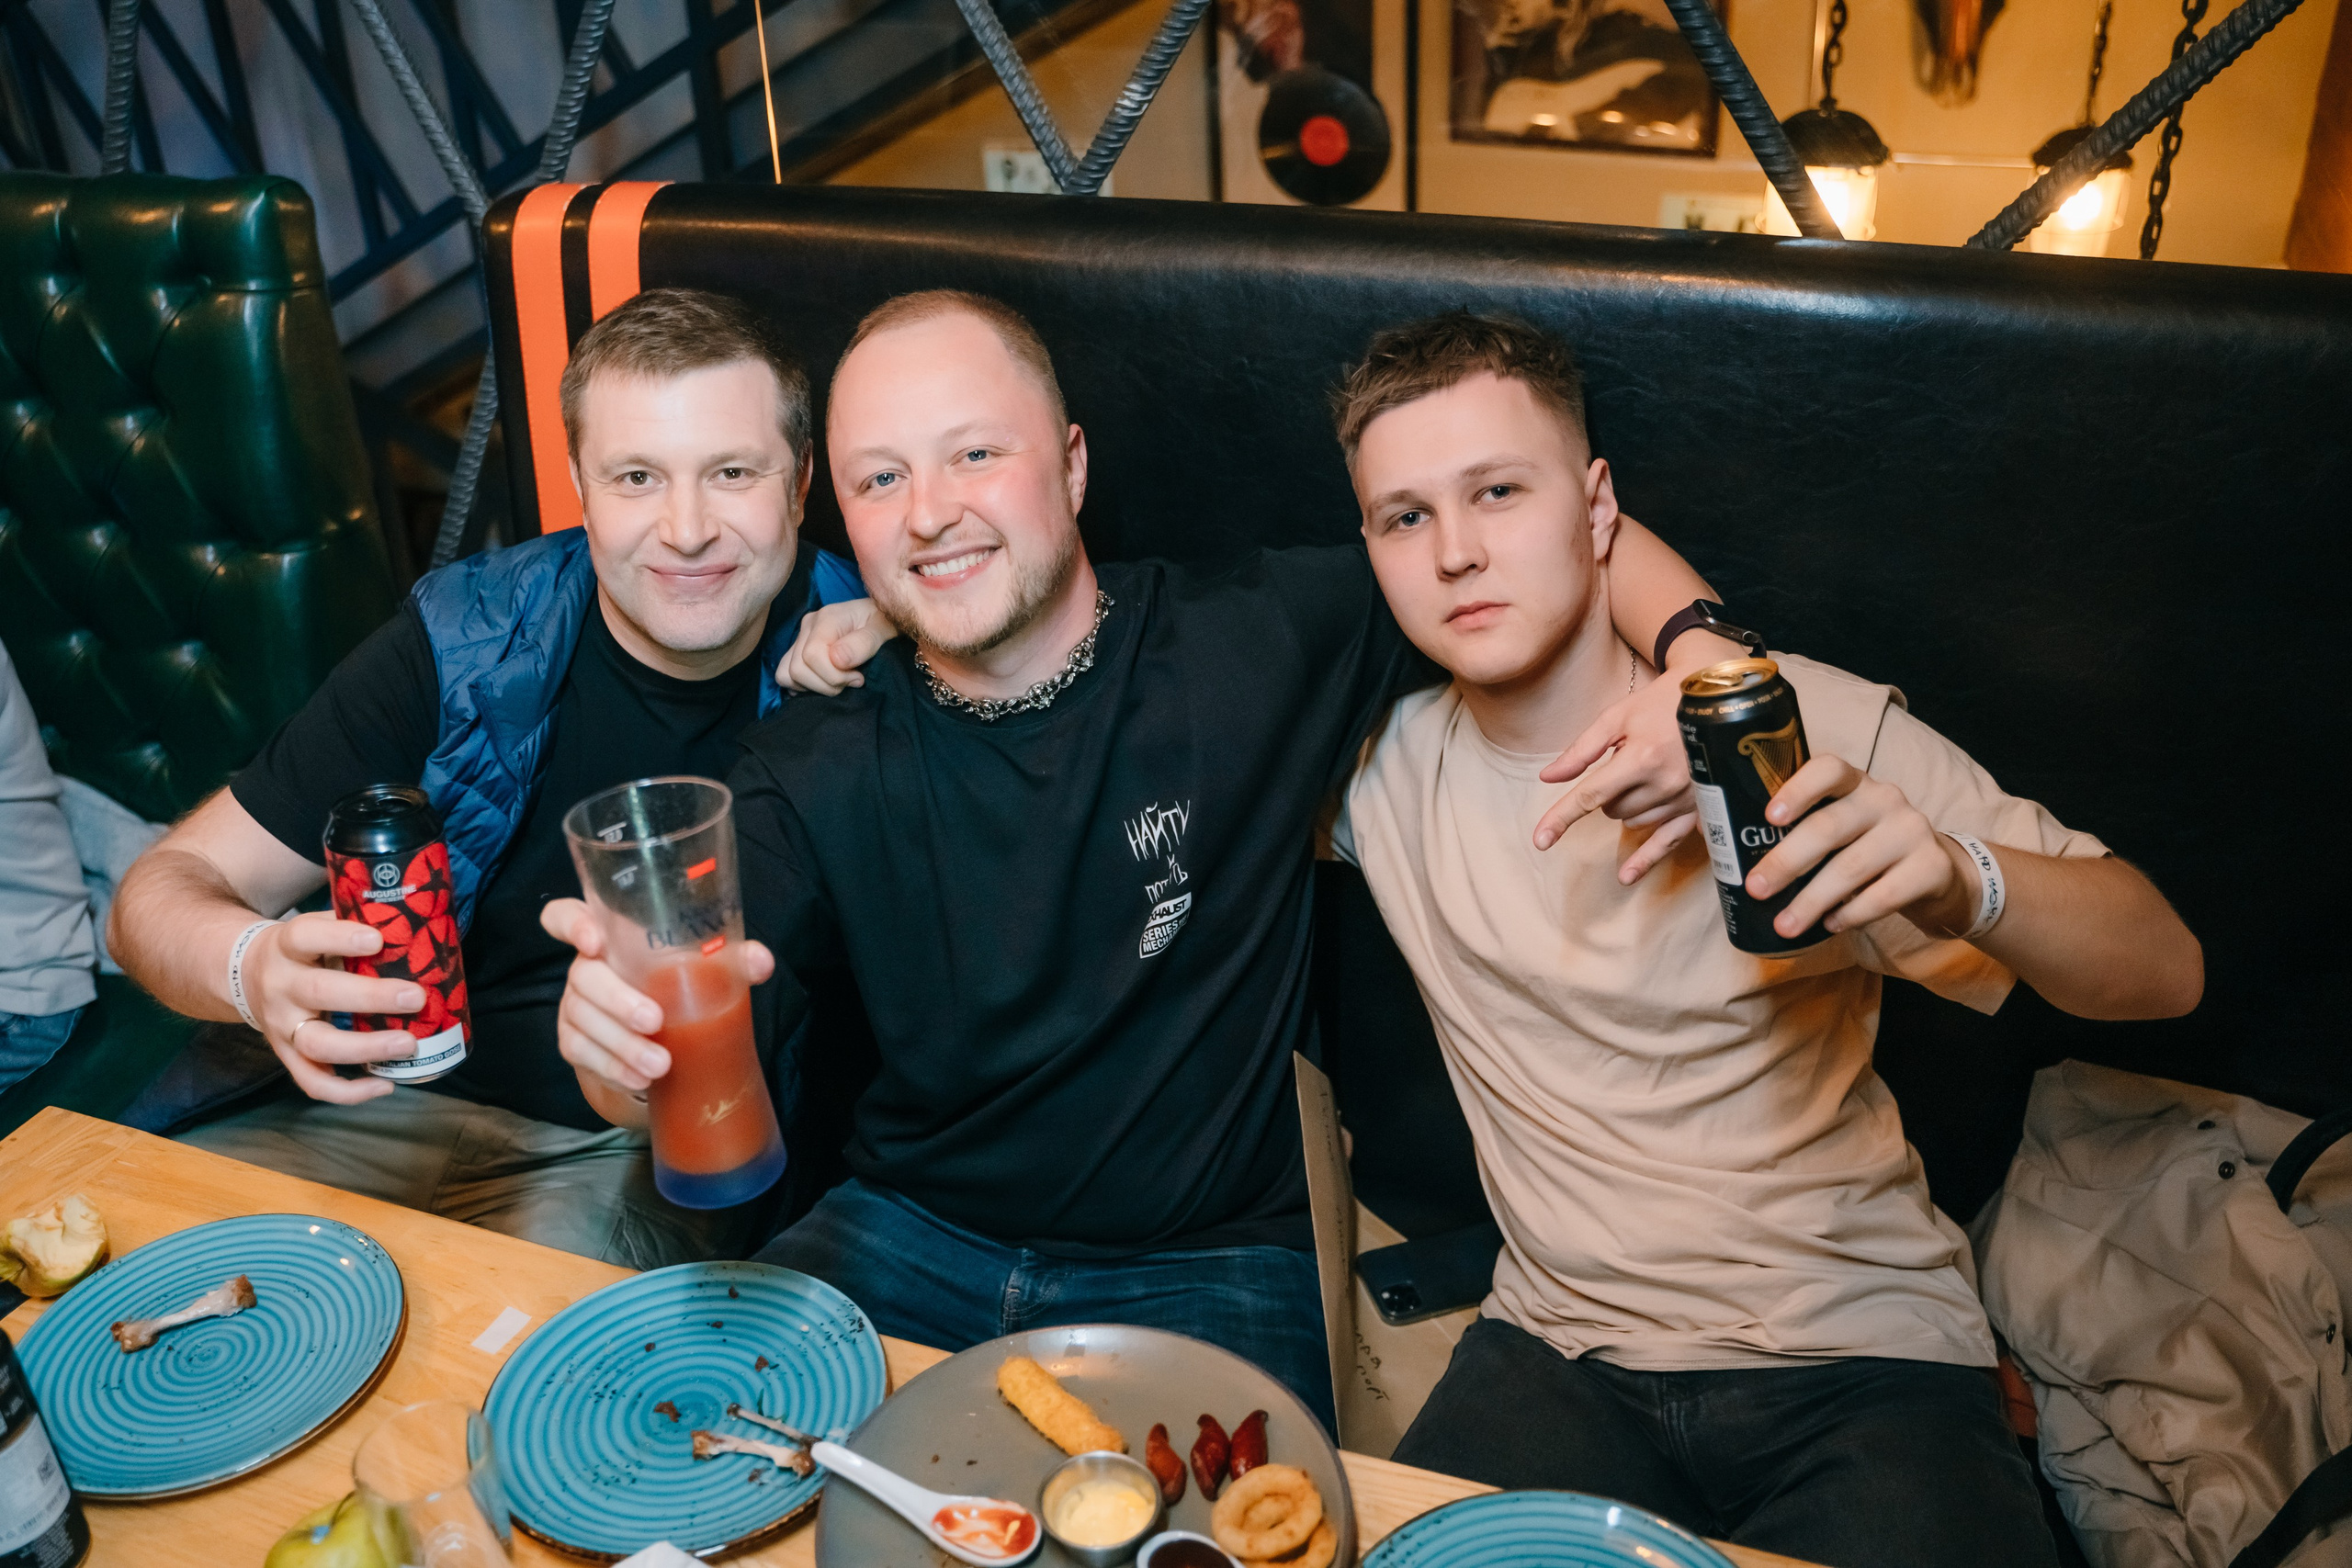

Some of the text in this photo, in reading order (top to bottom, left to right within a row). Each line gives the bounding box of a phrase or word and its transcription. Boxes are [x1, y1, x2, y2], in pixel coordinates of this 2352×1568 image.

[1740, 826, 1788, 847] GUI
[363, 884, 417, 899] AUGUSTINE
[1142, 919, 1179, 942] SERIES
[413, 1054, 444, 1067] TOMATO
